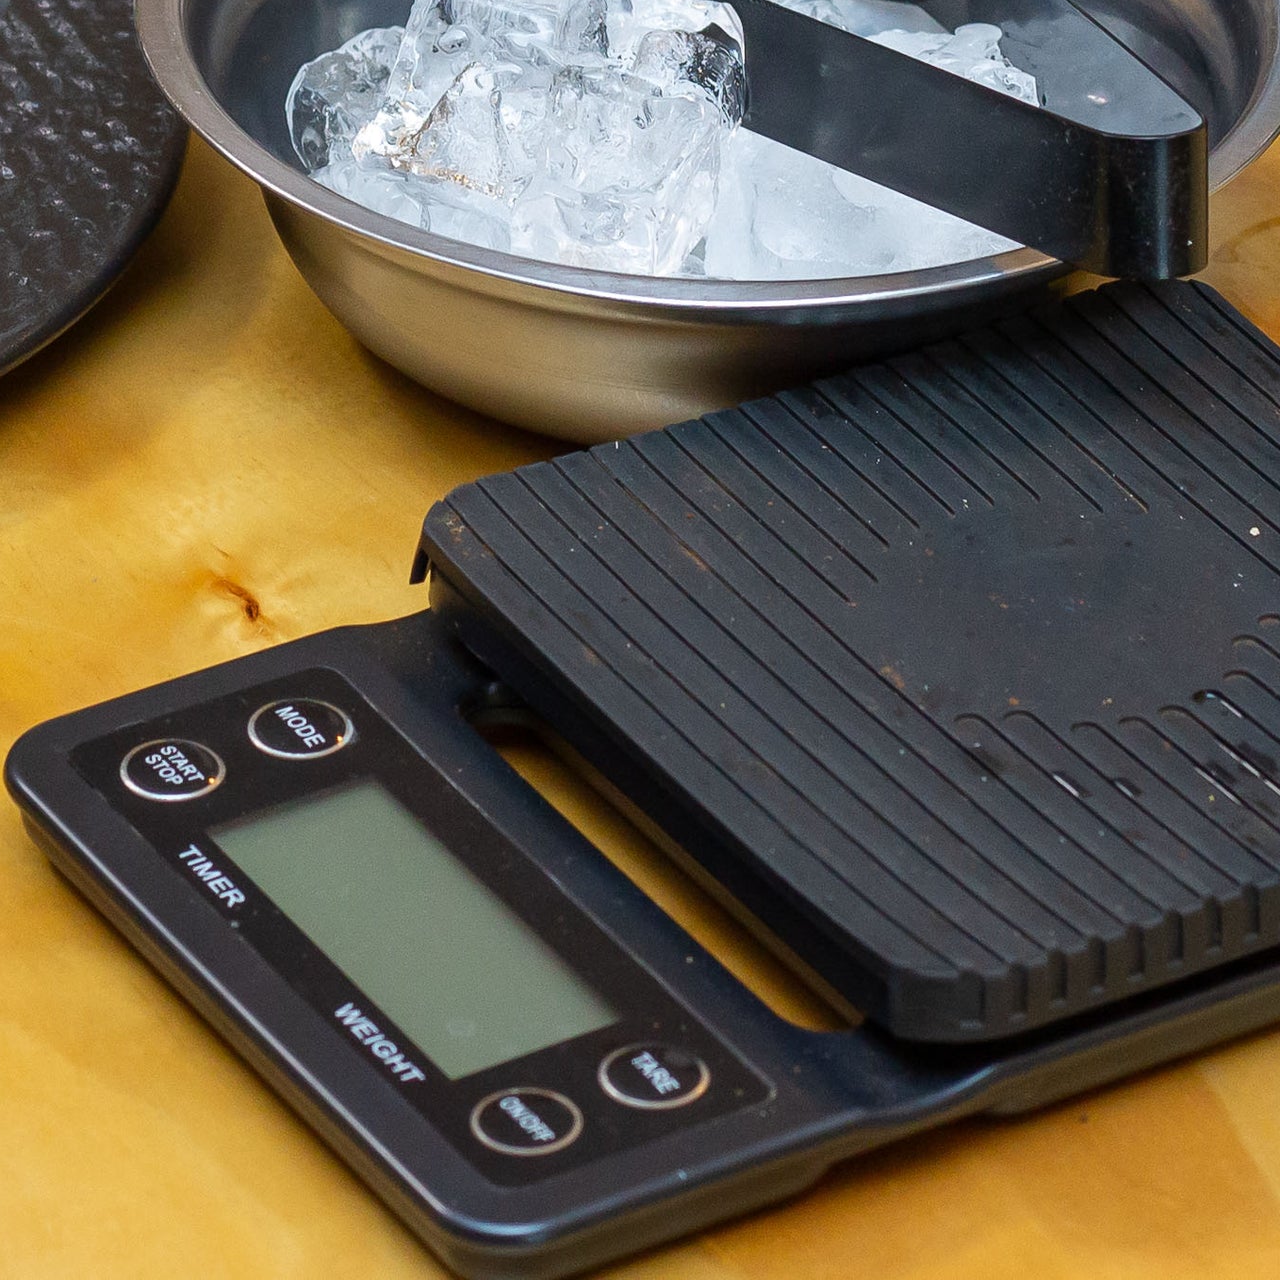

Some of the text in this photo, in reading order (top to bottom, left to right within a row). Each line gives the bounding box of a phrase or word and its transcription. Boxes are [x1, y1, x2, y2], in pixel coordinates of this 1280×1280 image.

[274, 705, 326, 749] MODE
[144, 753, 184, 786] STOP
[160, 745, 205, 783] START
[178, 843, 246, 908] TIMER
[334, 1002, 426, 1082] WEIGHT
[630, 1051, 681, 1095] TARE
[499, 1095, 556, 1142] ON/OFF
